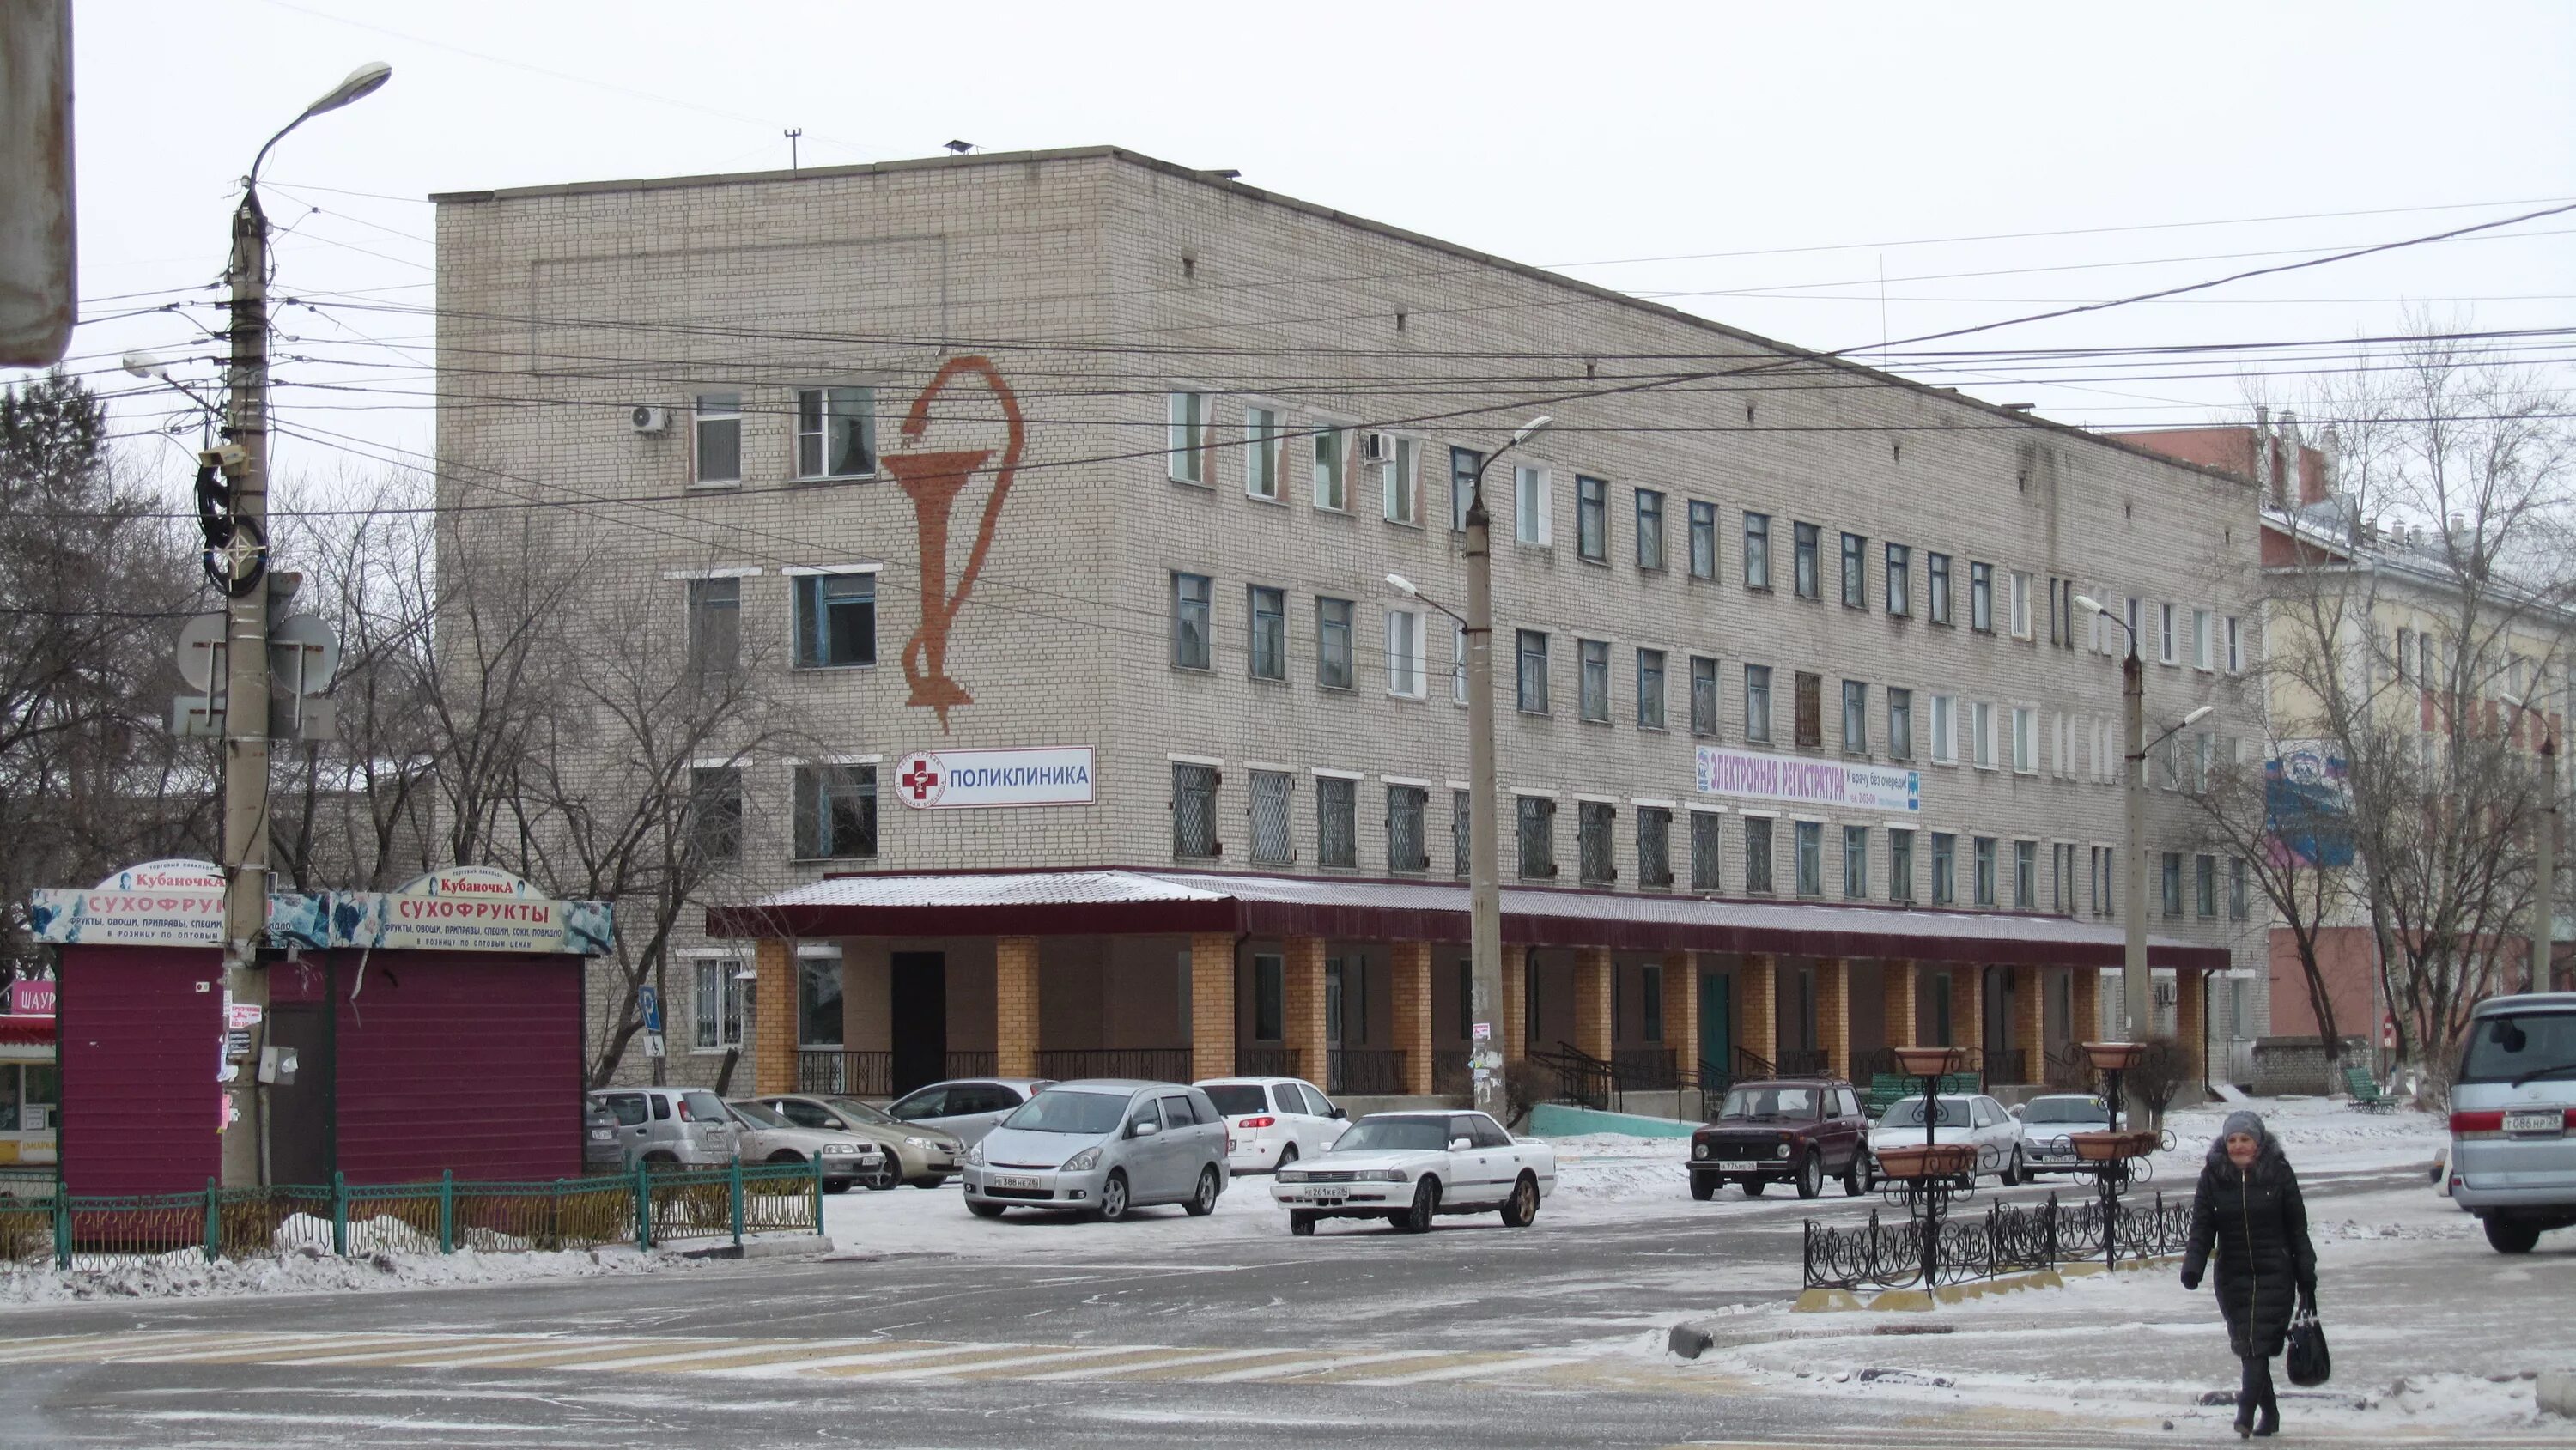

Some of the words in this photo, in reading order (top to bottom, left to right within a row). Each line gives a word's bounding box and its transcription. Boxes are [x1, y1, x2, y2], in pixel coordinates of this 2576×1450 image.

[950, 765, 1089, 788] ПОЛИКЛИНИКА
[1711, 752, 1777, 795] ЭЛЕКТРОННАЯ
[1783, 761, 1844, 802] РЕГИСТРАТУРА
[1846, 769, 1850, 782] К
[1852, 773, 1868, 788] врачу
[1870, 772, 1880, 786] без
[1881, 775, 1907, 790] очереди!
[70, 917, 104, 927] ФРУКТЫ,
[143, 919, 188, 928] ПРИПРАВЫ,
[399, 901, 550, 923] СУХОФРУКТЫ
[385, 924, 414, 934] ФРУКТЫ,
[445, 925, 481, 936] ПРИПРАВЫ,
[513, 927, 530, 937] СОКИ,
[532, 928, 562, 938] ПОВИДЛО
[426, 938, 455, 947] РОЗНИЦУ
